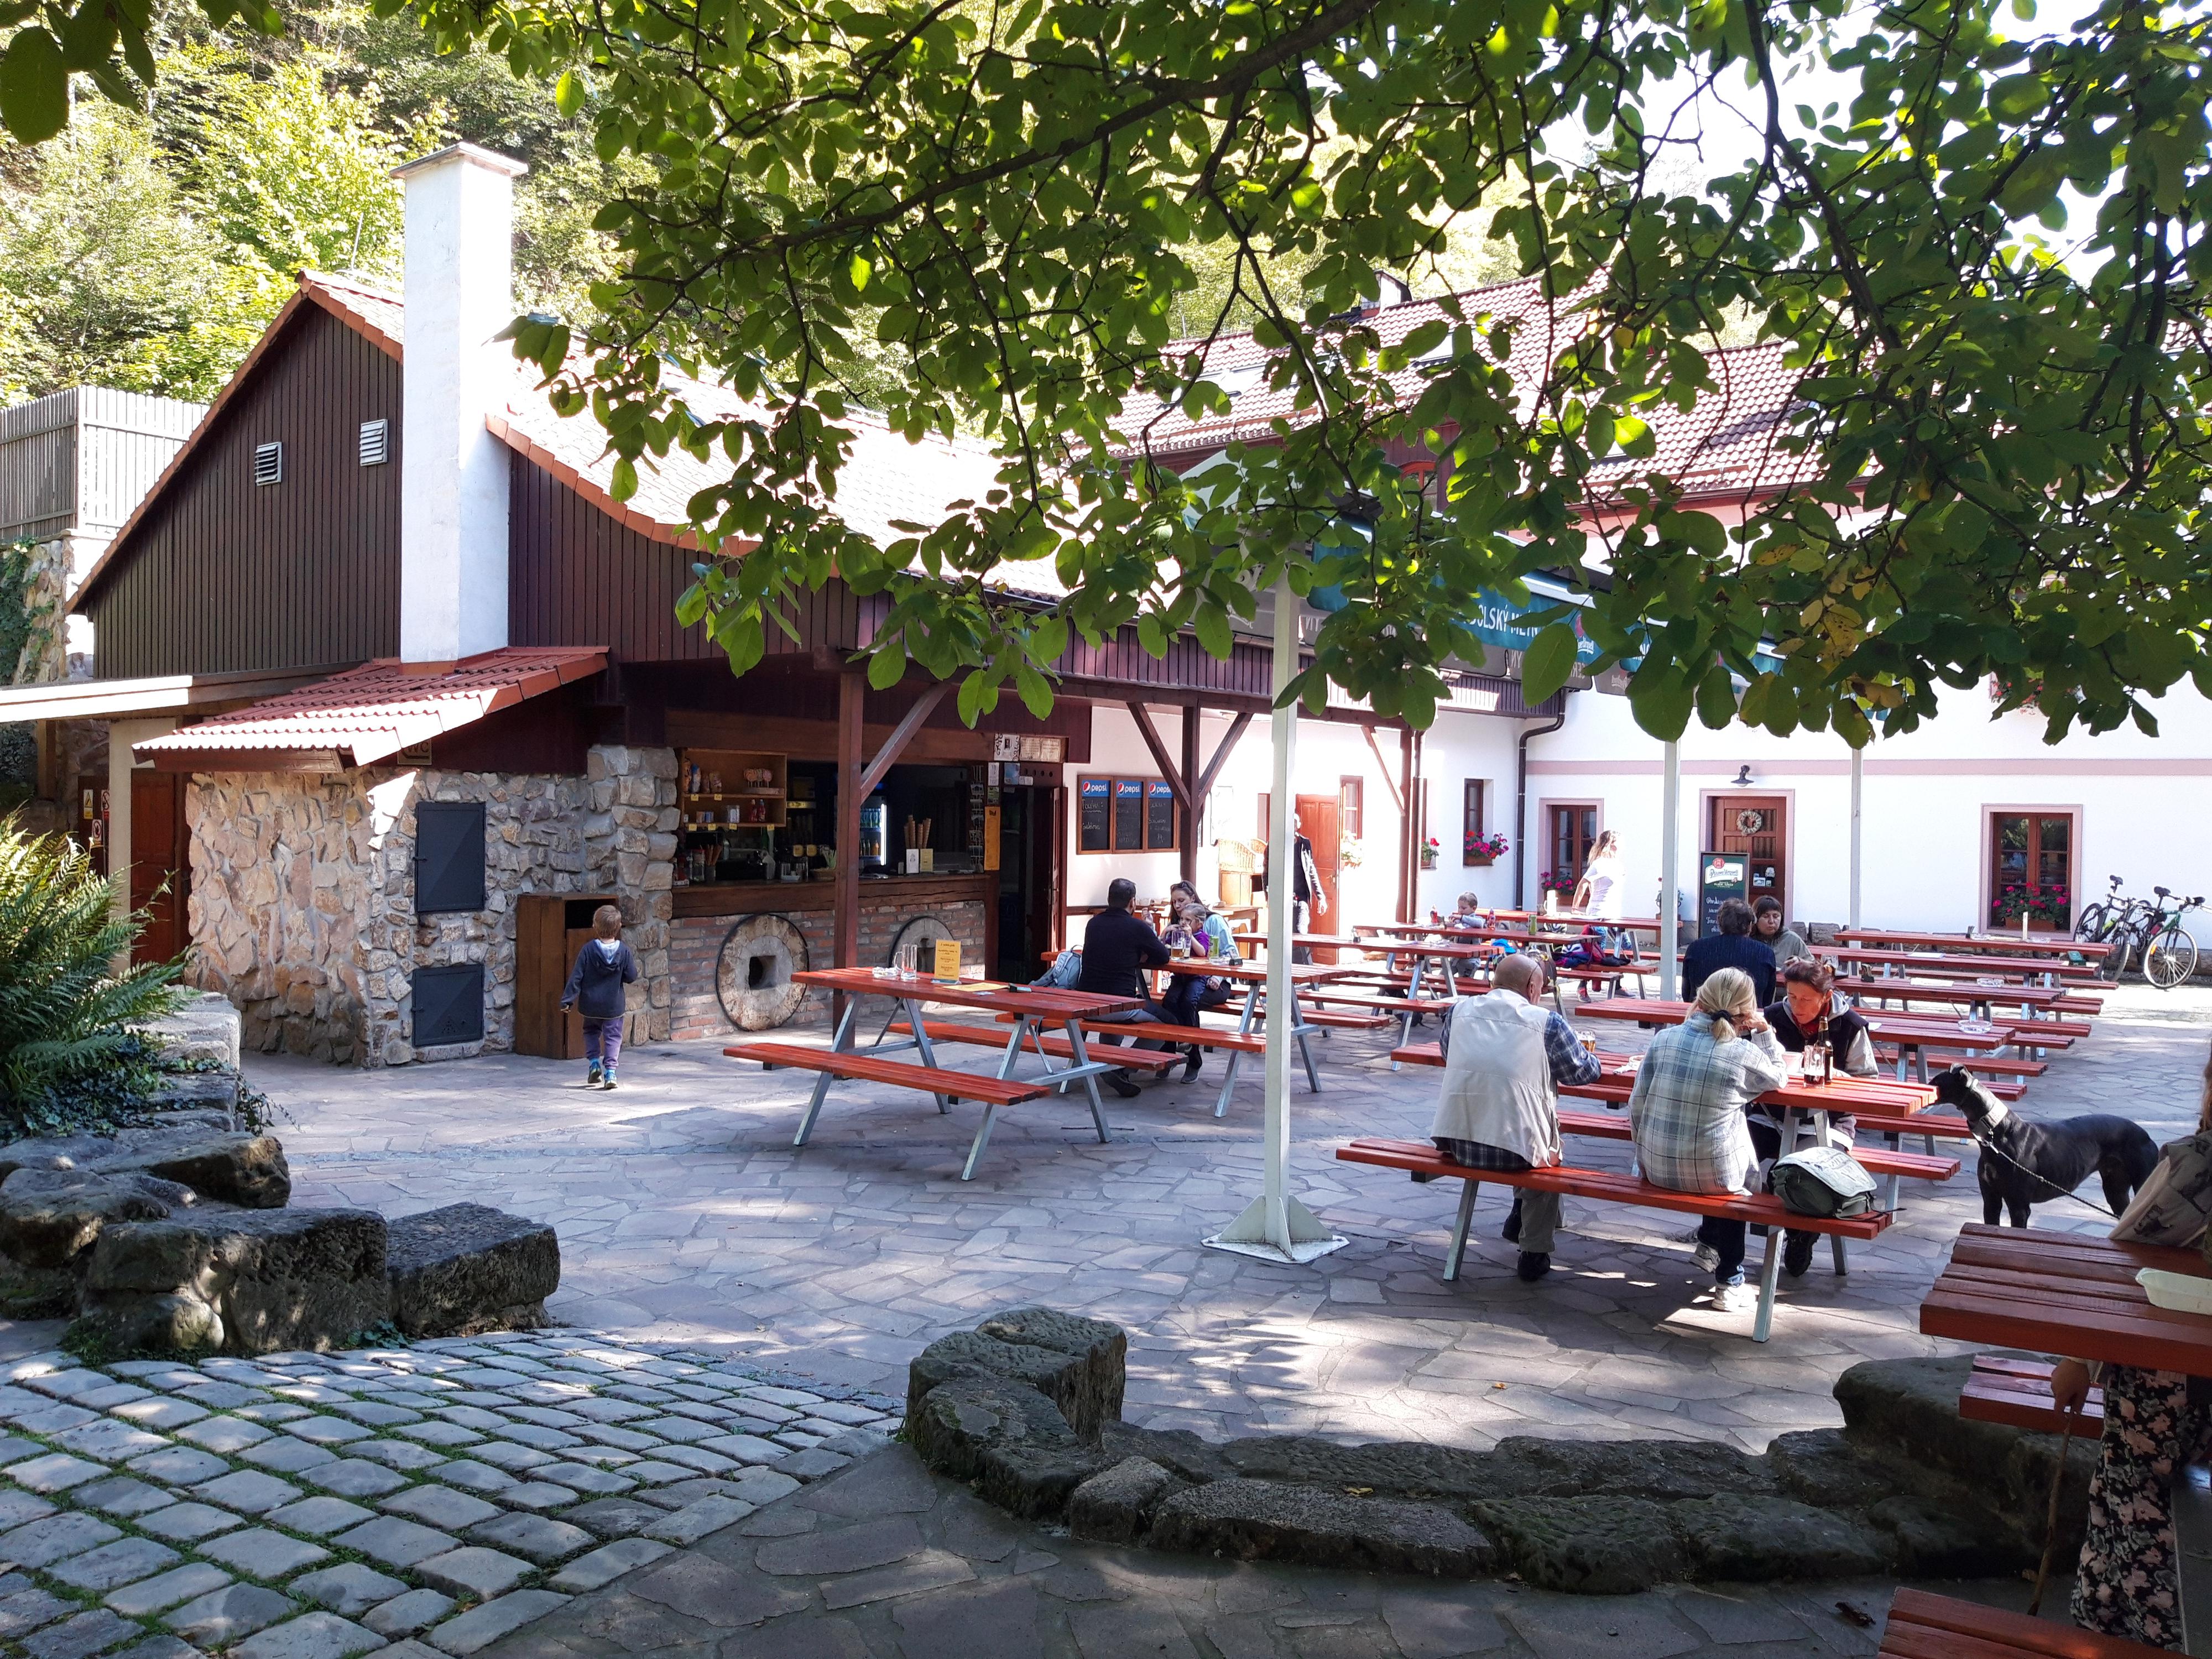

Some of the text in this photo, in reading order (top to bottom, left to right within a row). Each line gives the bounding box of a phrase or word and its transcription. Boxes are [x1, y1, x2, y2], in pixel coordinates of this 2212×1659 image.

[408, 742, 429, 753] WC
[1091, 784, 1107, 793] pepsi
[1125, 785, 1140, 794] pepsi
